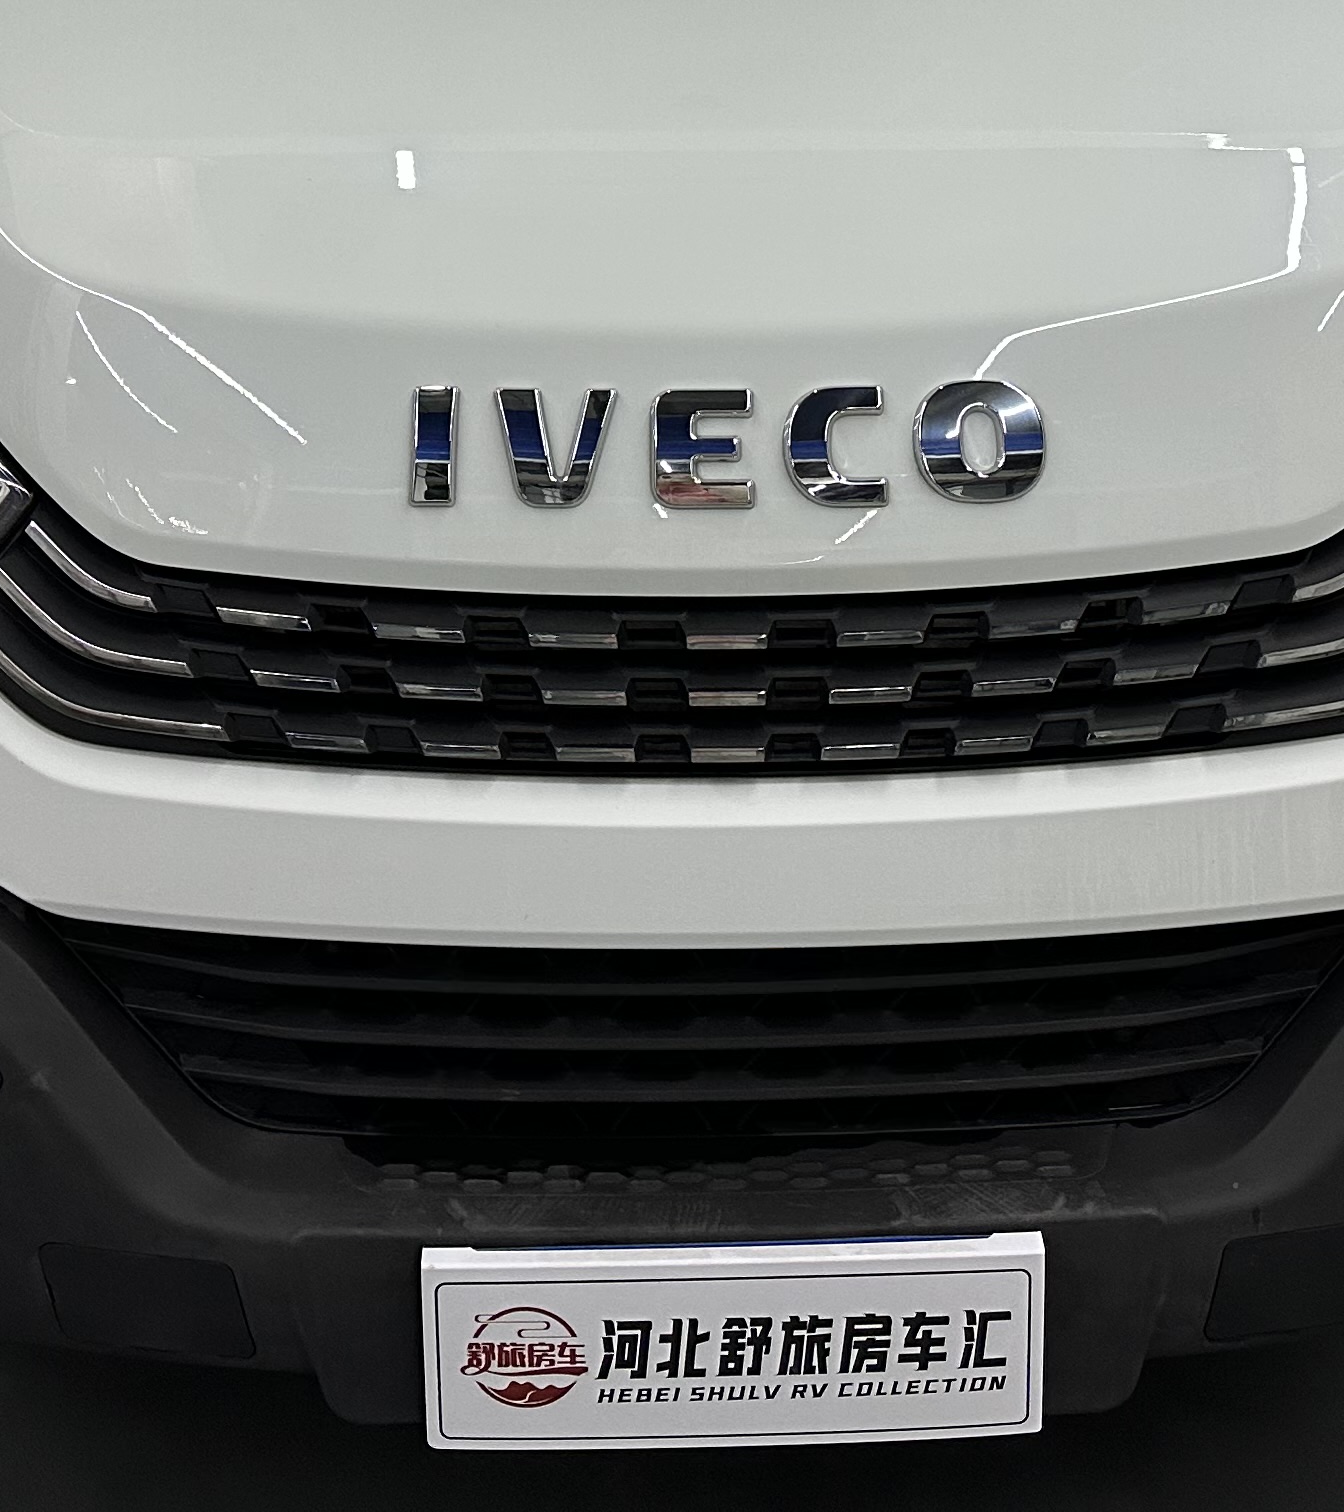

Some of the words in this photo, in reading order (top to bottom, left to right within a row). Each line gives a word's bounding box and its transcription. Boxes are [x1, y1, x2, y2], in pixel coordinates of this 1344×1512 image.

[409, 379, 1046, 509] IVECO
[460, 1341, 588, 1376] 舒旅房车
[595, 1309, 1012, 1380] 河北舒旅房车汇
[597, 1386, 681, 1404] HEBEI
[688, 1383, 782, 1403] SHULV
[790, 1382, 829, 1400] RV
[837, 1375, 1007, 1398] COLLECTION
